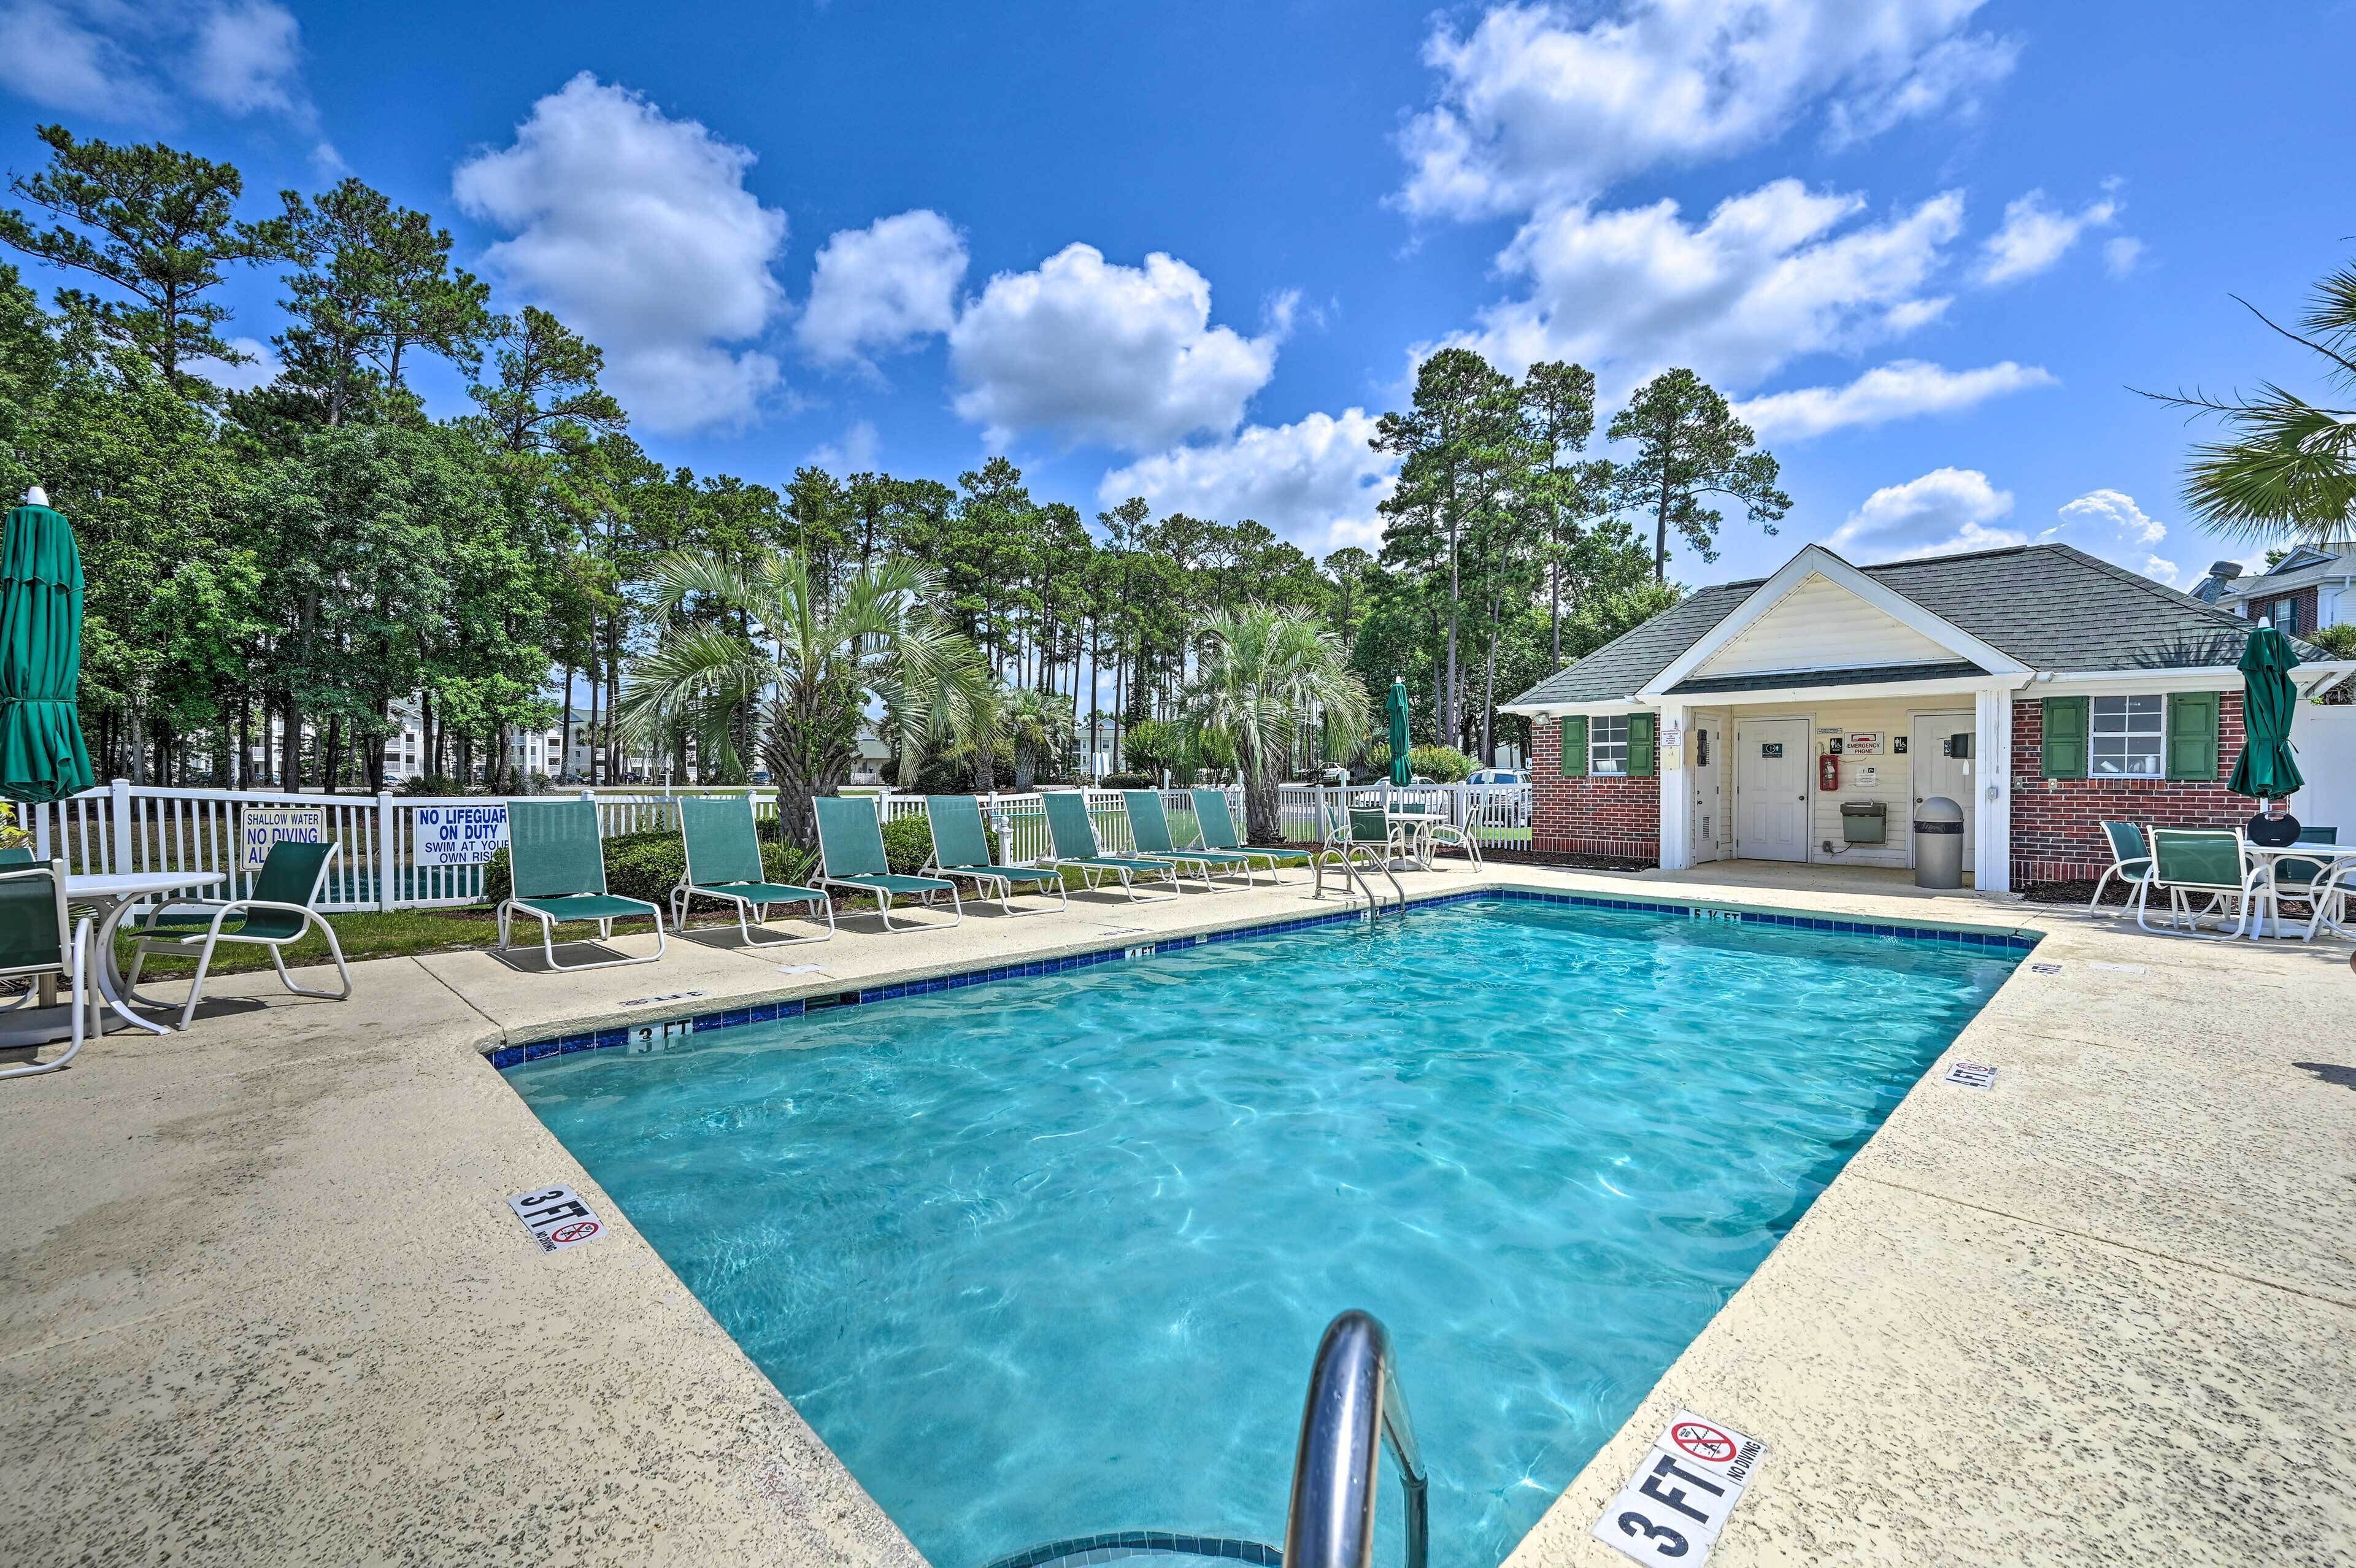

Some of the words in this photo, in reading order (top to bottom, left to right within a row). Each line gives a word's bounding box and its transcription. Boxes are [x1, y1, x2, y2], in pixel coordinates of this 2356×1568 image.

[247, 813, 288, 825] SHALLOW
[291, 813, 318, 825] WATER
[420, 809, 439, 824] NO
[446, 809, 507, 824] LIFEGUAR
[247, 828, 267, 845] NO
[272, 828, 318, 844] DIVING
[439, 825, 458, 840] ON
[464, 824, 498, 840] DUTY
[425, 841, 455, 853] SWIM
[461, 841, 475, 851] AT
[439, 852, 466, 863] OWN
[639, 1028, 653, 1042] 3
[663, 1018, 691, 1039] FT
[1945, 1078, 1988, 1087] 4
[1953, 1069, 1988, 1082] FT
[520, 1190, 564, 1207] 3
[523, 1200, 590, 1228] FT
[539, 1237, 557, 1251] DIVING
[1734, 1441, 1761, 1469] DIVING
[1727, 1466, 1746, 1482] NO
[1639, 1454, 1725, 1524] FT
[1617, 1511, 1689, 1558] 3
